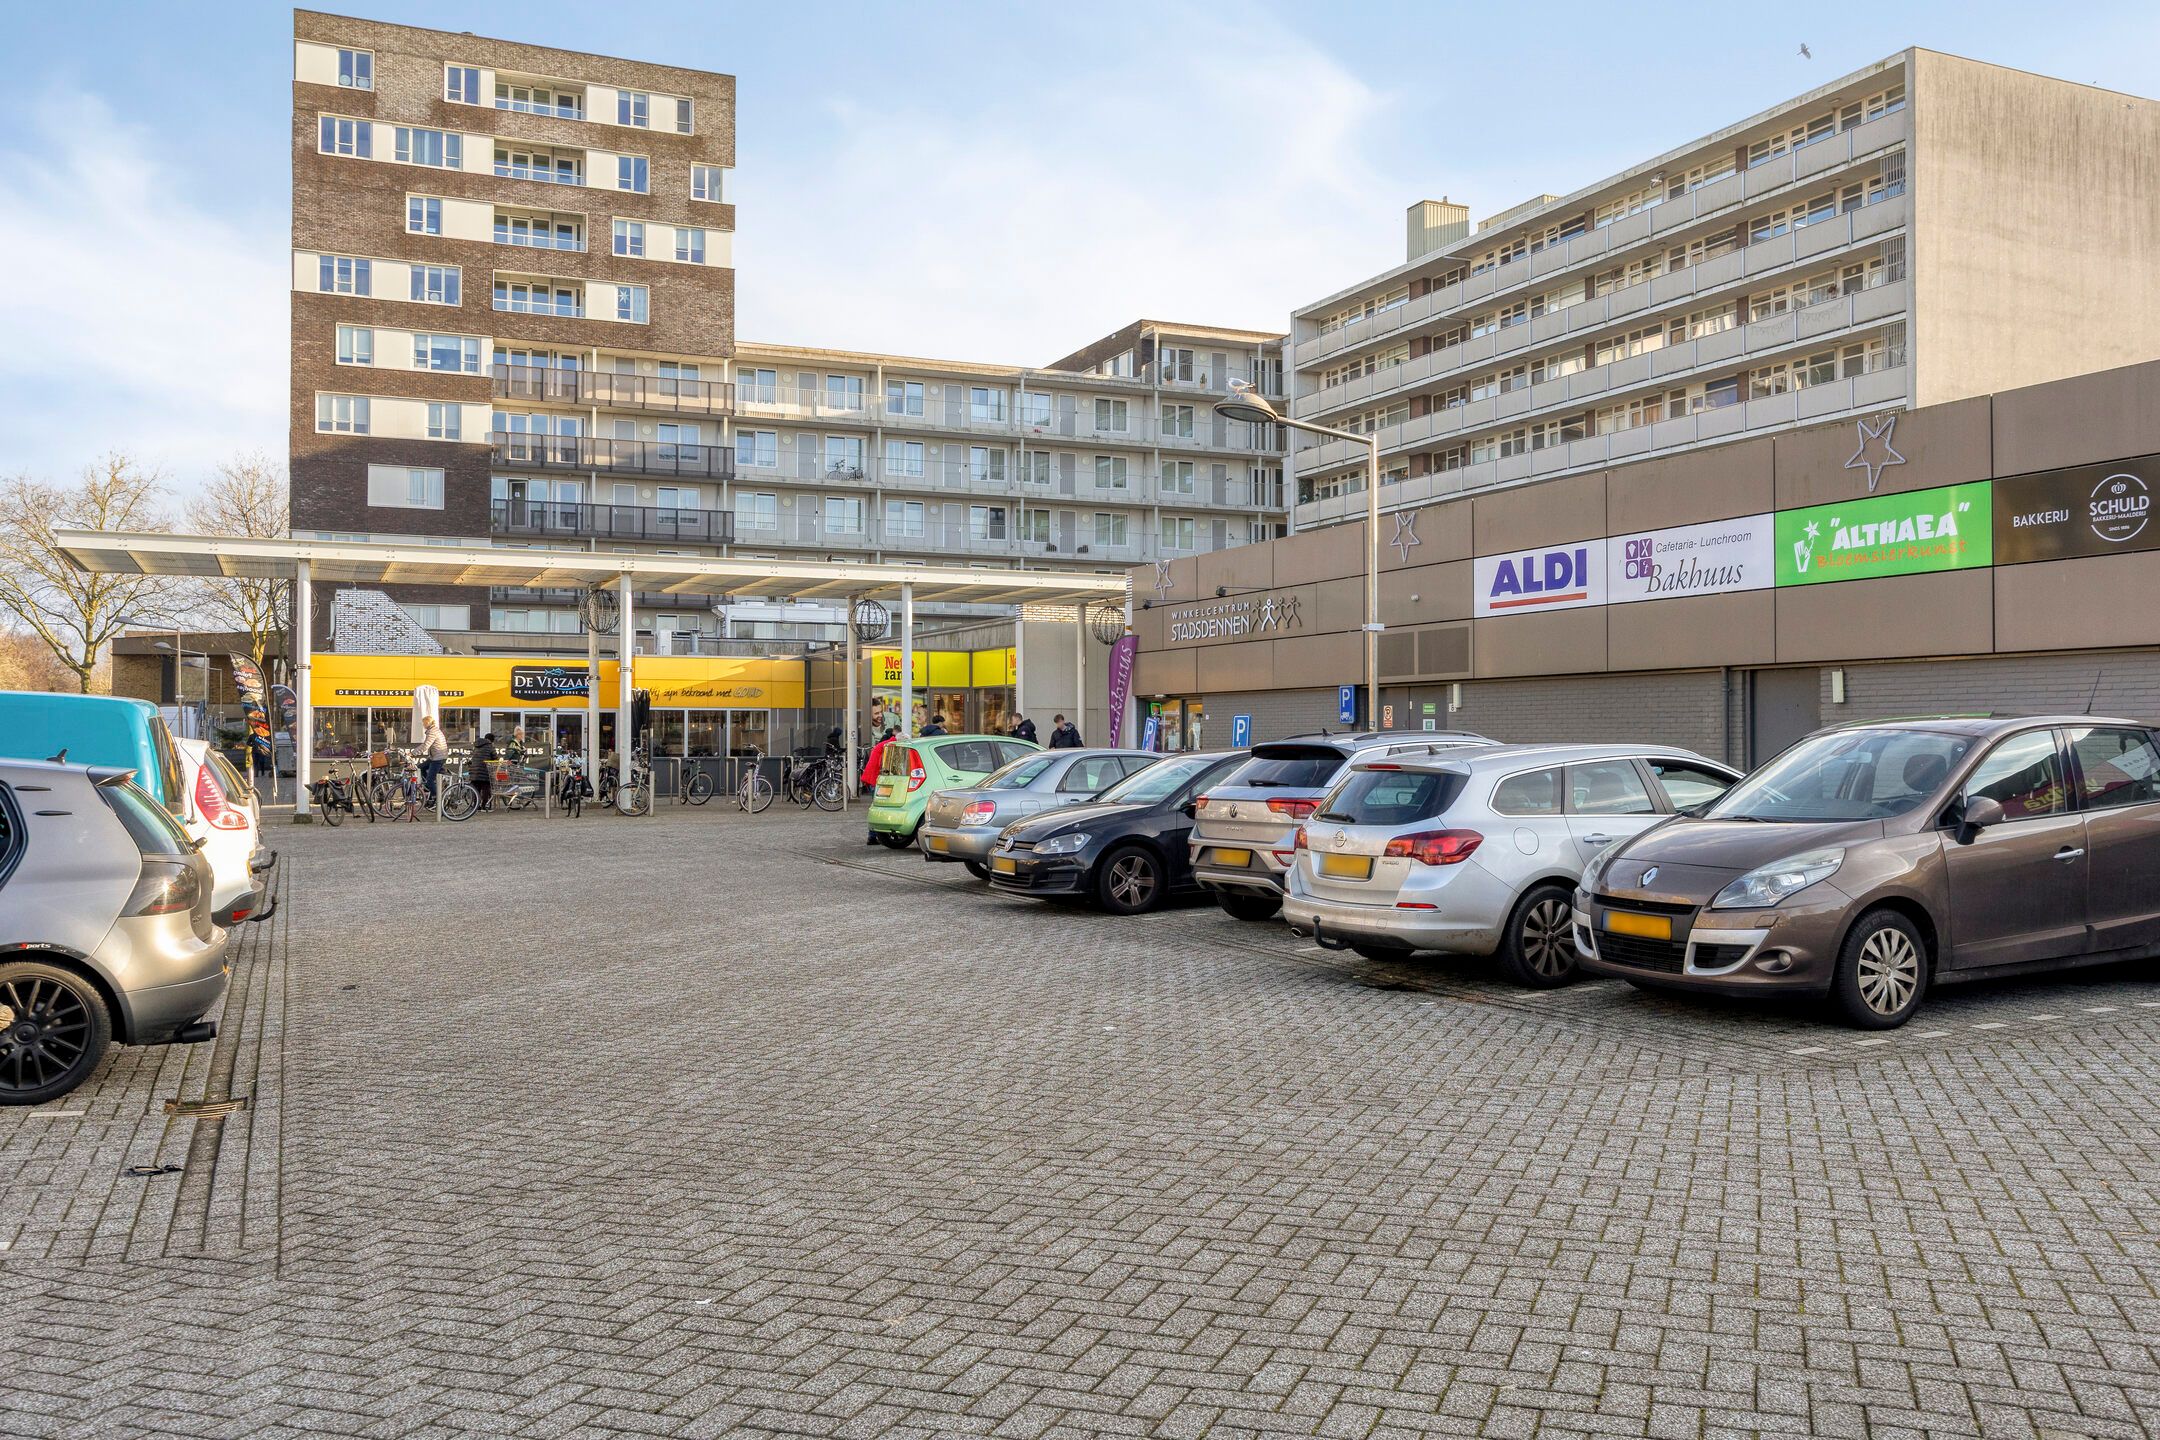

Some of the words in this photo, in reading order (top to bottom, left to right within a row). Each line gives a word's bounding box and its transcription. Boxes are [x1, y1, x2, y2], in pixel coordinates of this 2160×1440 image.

[2089, 495, 2150, 516] SCHULD
[2013, 509, 2069, 528] BAKKERIJ
[2092, 510, 2147, 523] BAKKERIJ-MAALDERIJ
[1700, 531, 1752, 547] Lunchroom
[1816, 539, 1968, 569] Bloemsierkunst
[1490, 548, 1587, 598] ALDI
[1645, 557, 1744, 593] Bakhuus
[1171, 601, 1250, 620] WINKELCENTRUM
[1171, 614, 1250, 641] STADSDENNEN
[663, 687, 678, 701] zijn
[681, 687, 714, 698] bekroond
[716, 687, 732, 698] met
[1342, 688, 1351, 708] P
[1145, 721, 1154, 741] P
[1236, 719, 1246, 742] P
